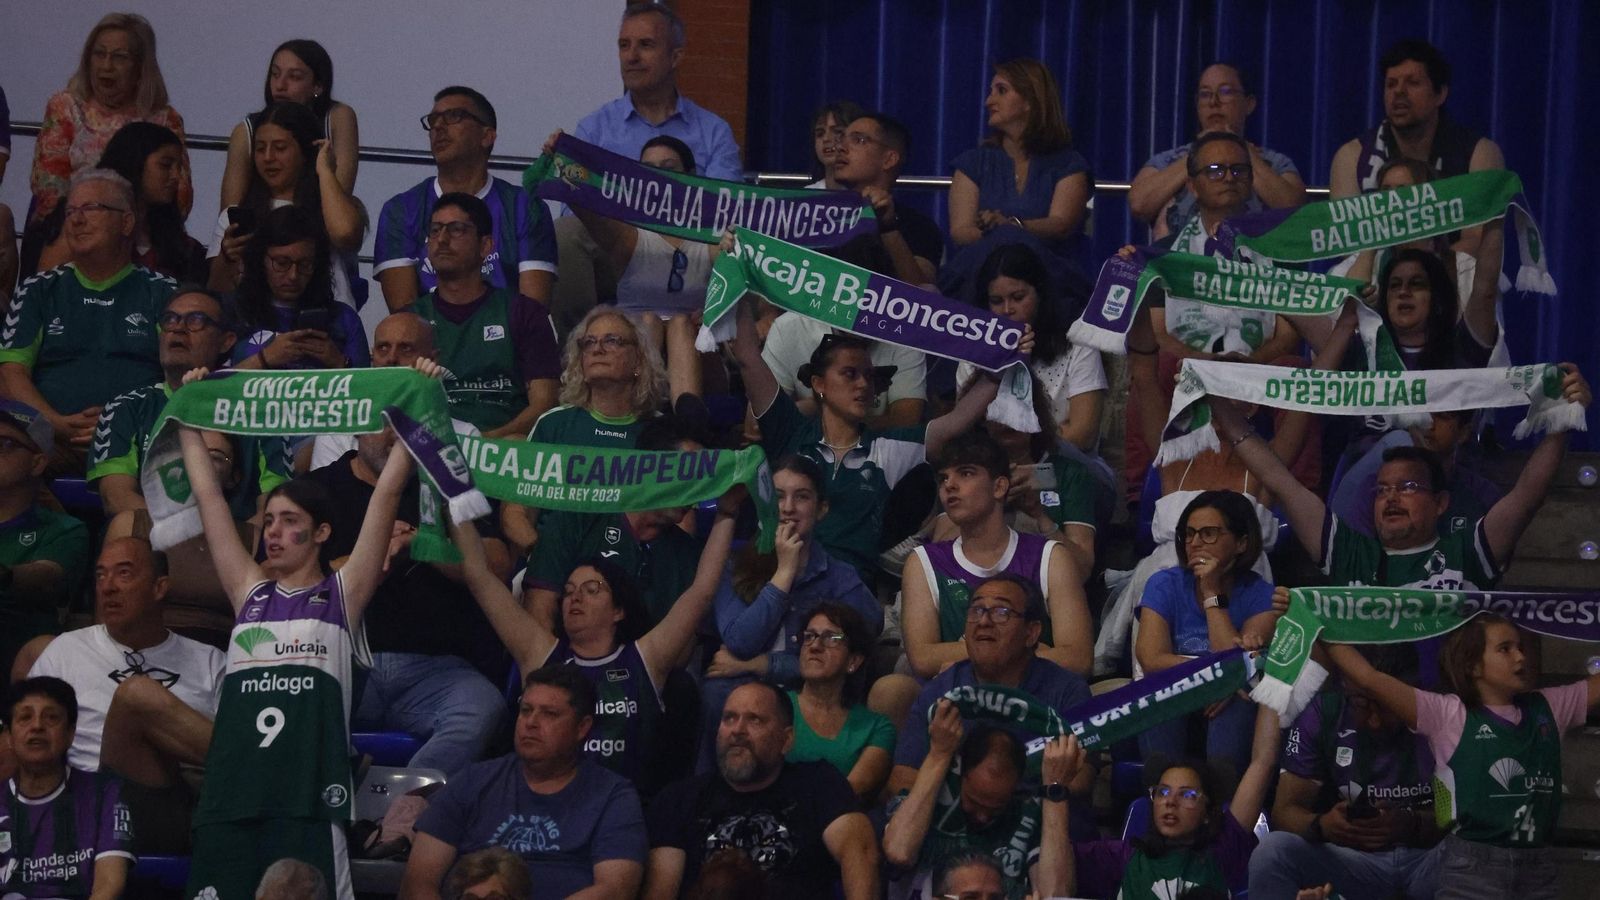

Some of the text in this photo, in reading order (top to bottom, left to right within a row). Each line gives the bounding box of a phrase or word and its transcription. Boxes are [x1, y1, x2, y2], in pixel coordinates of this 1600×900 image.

[600, 170, 704, 233] UNICAJA
[1328, 182, 1437, 224] UNICAJA
[1310, 198, 1465, 253] BALONCESTO
[1192, 271, 1349, 309] BALONCESTO
[832, 271, 1023, 351] Baloncesto
[242, 374, 354, 399] UNICAJA
[213, 398, 373, 429] BALONCESTO
[595, 428, 627, 439] hummel
[516, 482, 621, 503] COPA DEL REY 2023
[274, 638, 329, 656] Unicaja
[241, 671, 314, 696] málaga
[255, 706, 286, 749] 9
[22, 864, 79, 884] Unicaja
